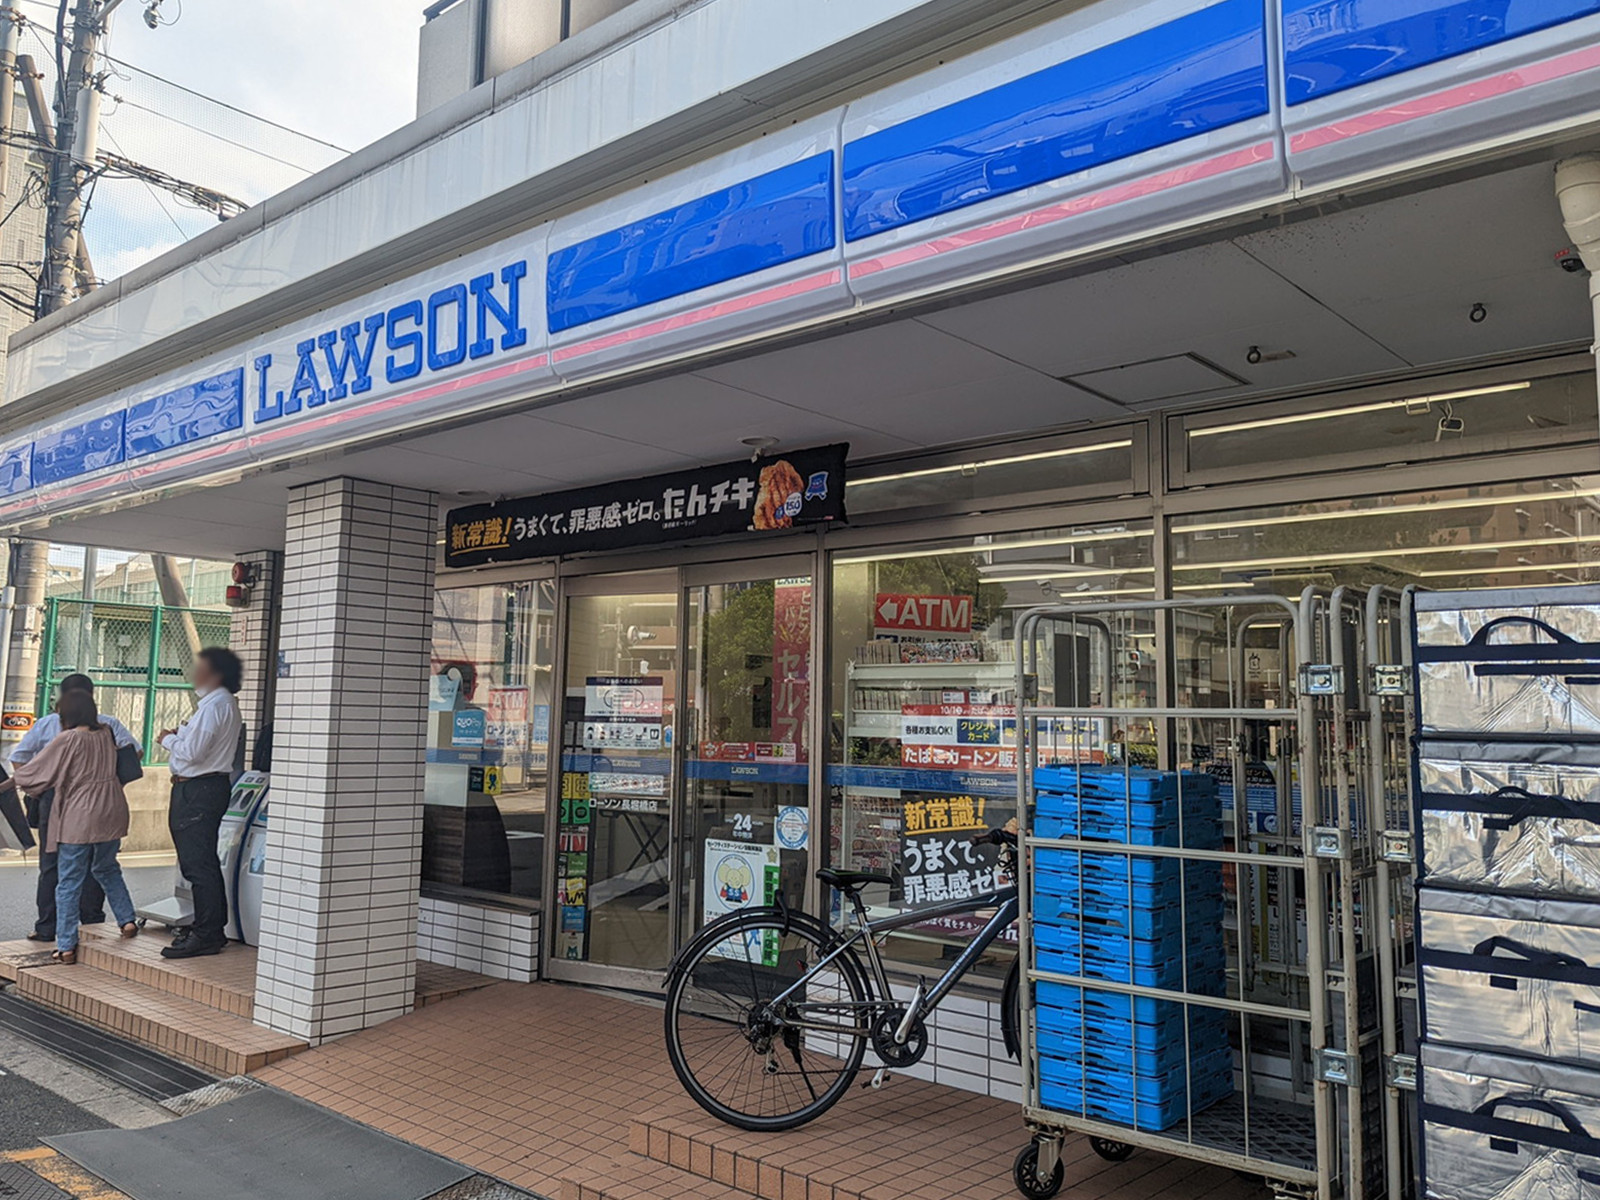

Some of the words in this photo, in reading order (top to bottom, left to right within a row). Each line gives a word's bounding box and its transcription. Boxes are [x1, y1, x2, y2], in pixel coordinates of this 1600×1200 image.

[253, 260, 527, 424] LAWSON
[452, 517, 512, 549] 新常識!
[663, 477, 755, 520] たんチキ
[898, 597, 968, 628] ATM
[961, 722, 997, 731] クレジット
[968, 733, 989, 741] カード
[904, 748, 1046, 769] たばこカートン販中
[733, 813, 753, 831] 24
[904, 796, 986, 830] 新常識!
[903, 838, 985, 873] うまくて、
